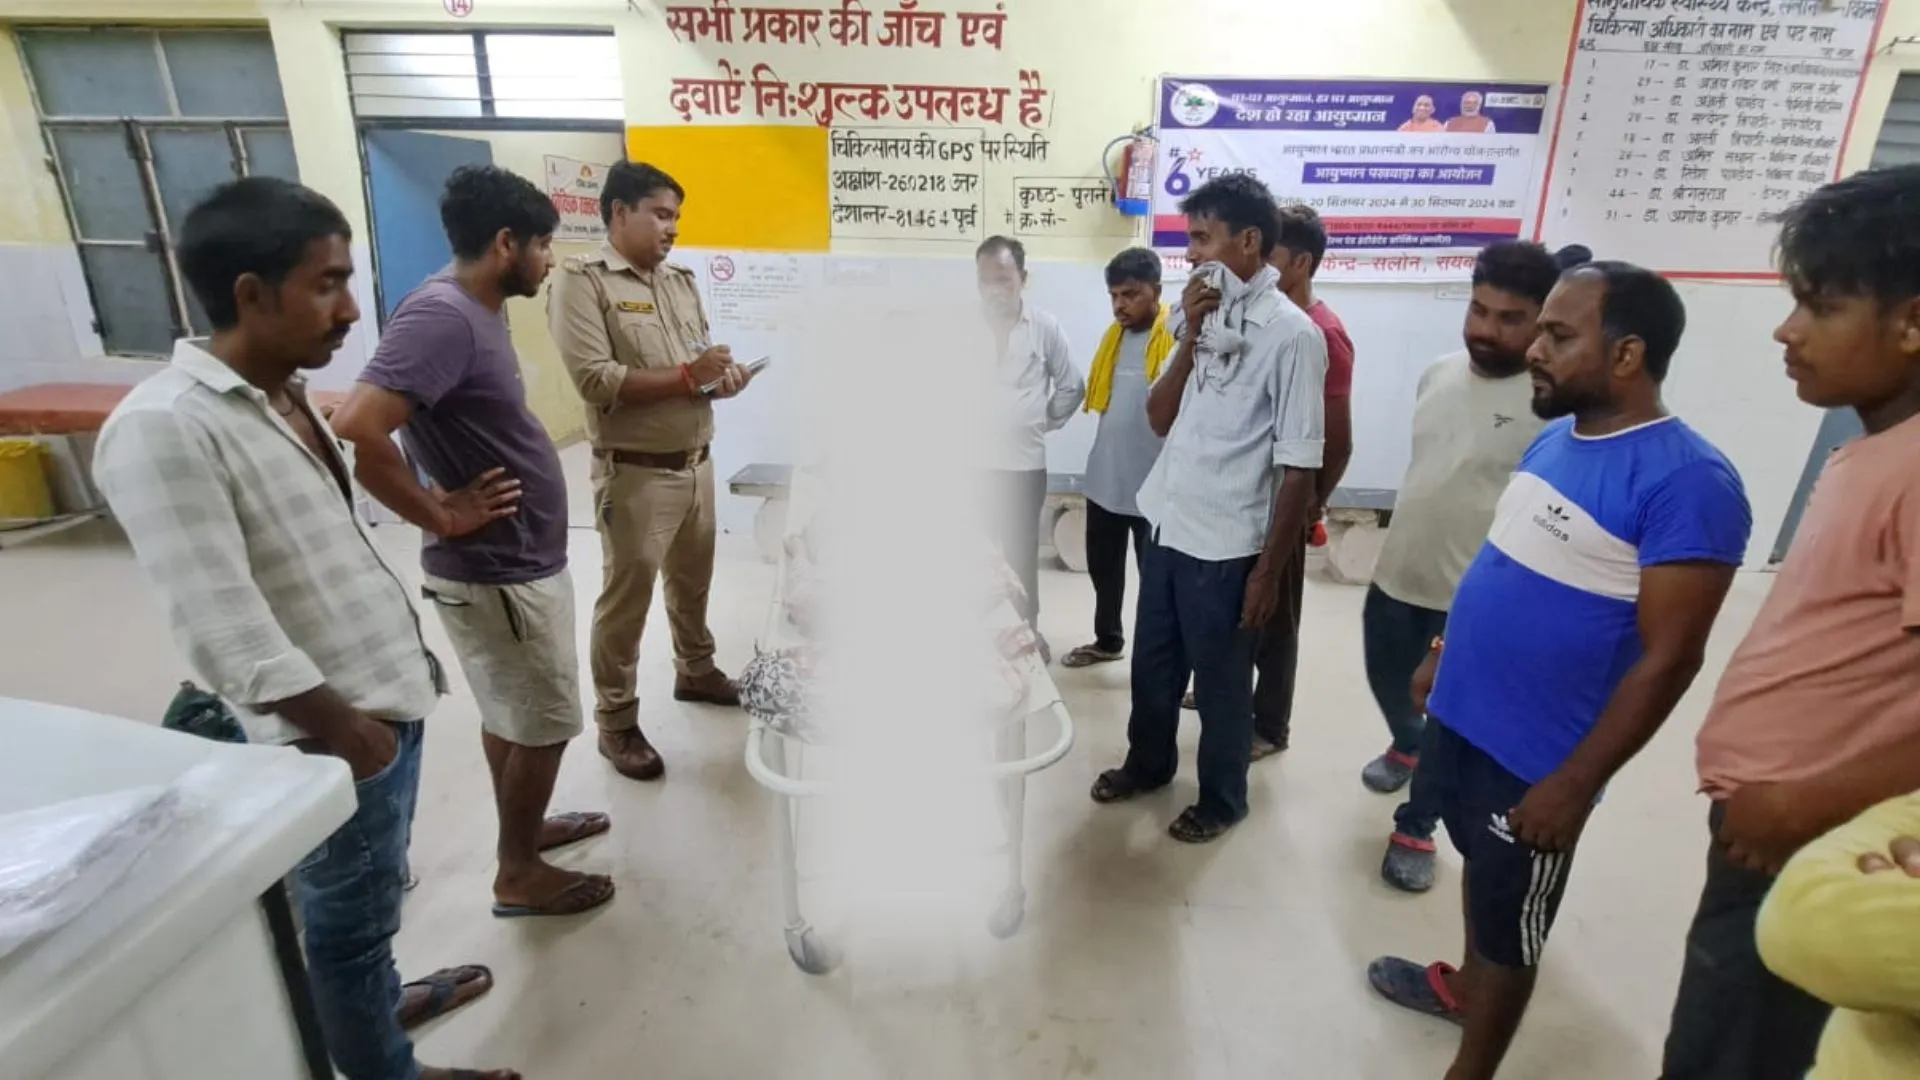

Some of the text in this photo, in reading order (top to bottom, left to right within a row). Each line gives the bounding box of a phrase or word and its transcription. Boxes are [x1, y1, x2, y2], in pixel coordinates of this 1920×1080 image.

[666, 0, 736, 43] सभी
[740, 7, 823, 47] प्रकार
[829, 0, 872, 47] की
[957, 2, 1007, 51] एवं
[892, 84, 1011, 126] उपलब्ध
[1235, 104, 1387, 127] देश हो रहा आयुष्मान
[913, 132, 936, 160] की
[938, 142, 975, 162] GPS
[980, 140, 1001, 162] पर
[1003, 132, 1050, 161] स्थिति
[1164, 157, 1191, 196] 6
[1368, 198, 1396, 208] 2024
[1411, 198, 1426, 208] 30
[1468, 198, 1495, 209] 2024
